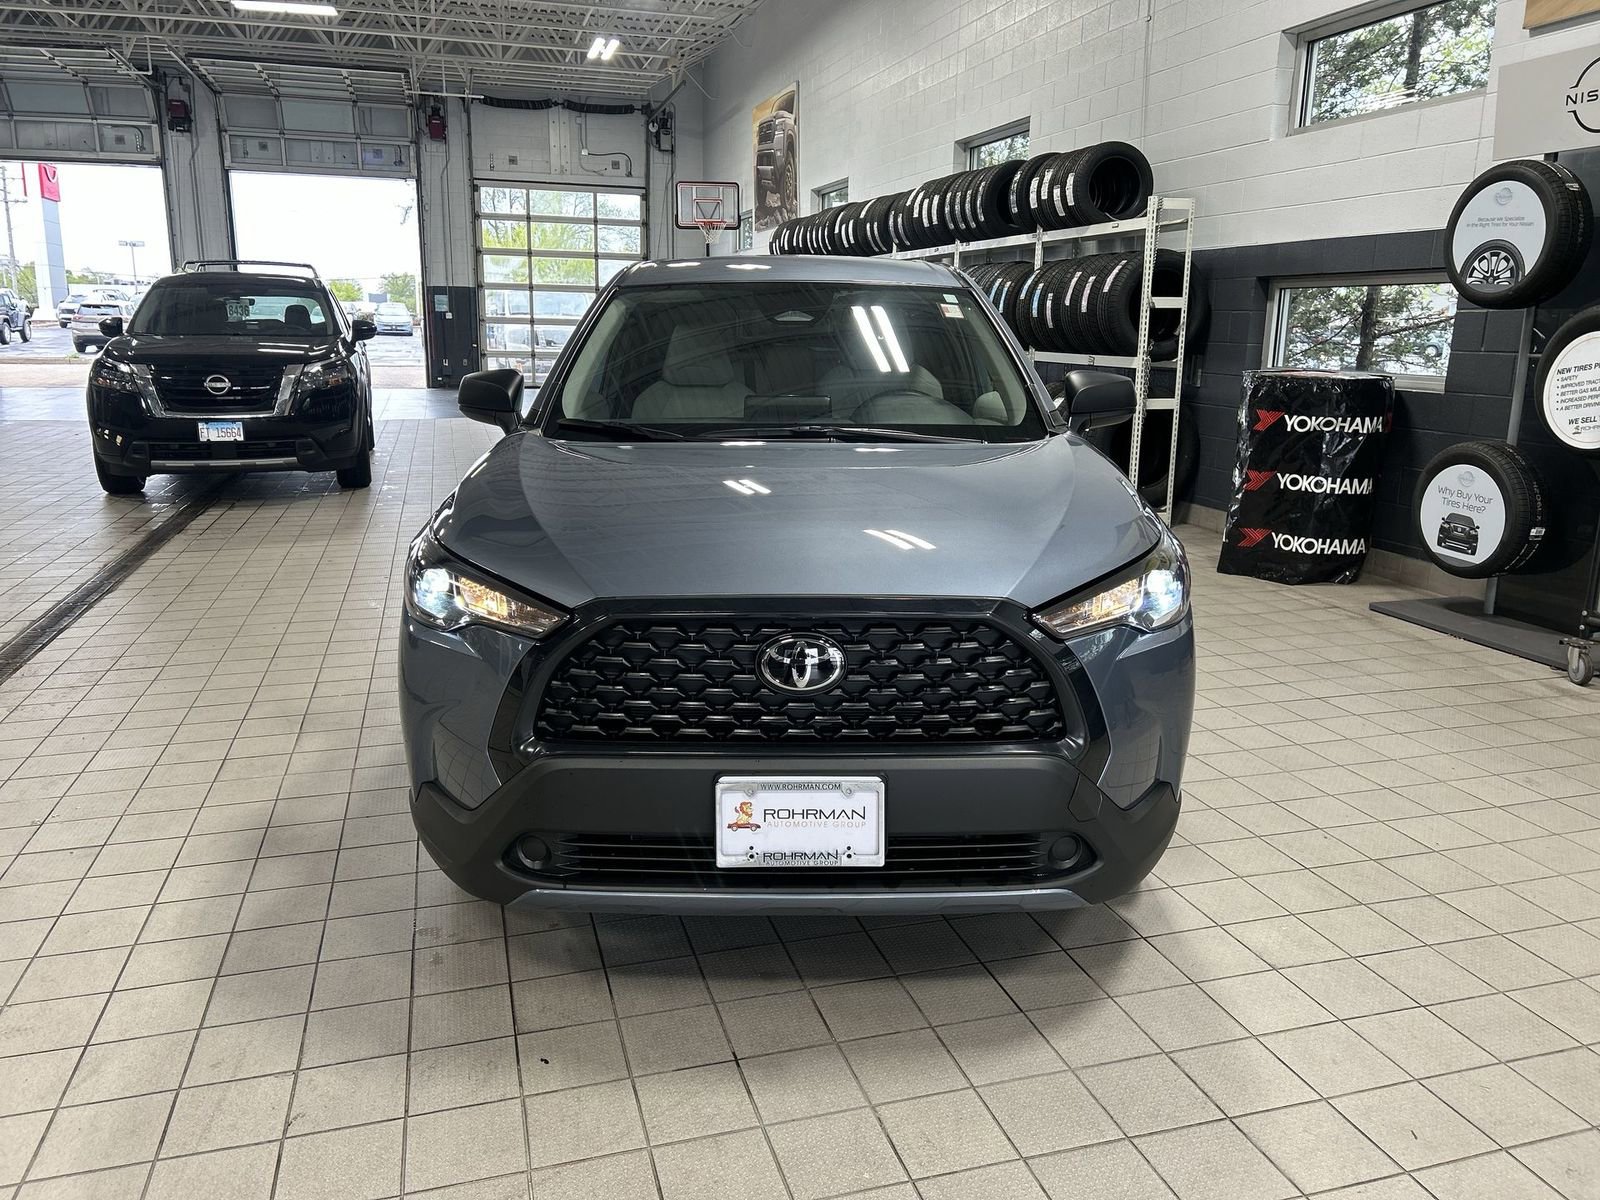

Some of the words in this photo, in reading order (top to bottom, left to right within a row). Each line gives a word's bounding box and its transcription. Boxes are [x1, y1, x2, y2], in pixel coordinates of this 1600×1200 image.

[1557, 367, 1573, 375] NEW
[1573, 363, 1593, 373] TIRES
[1560, 389, 1578, 397] BETTER
[1564, 403, 1582, 411] BETTER
[1284, 414, 1383, 433] YOKOHAMA
[1568, 417, 1579, 425] WE
[1581, 416, 1597, 424] SELL
[199, 427, 210, 438] FT
[1438, 485, 1455, 497] Why
[1456, 489, 1472, 501] Buy
[1474, 494, 1493, 505] Your
[1442, 496, 1461, 509] Tires
[1461, 502, 1486, 514] Here?
[1271, 532, 1366, 555] YOKOHAMA
[760, 783, 841, 791] WWW.ROHRMAN.COM
[763, 806, 866, 823] ROHRMAN
[766, 820, 828, 828] AUTOMOTIVE
[833, 820, 866, 828] GROUP
[764, 849, 839, 862] ROHRMAN
